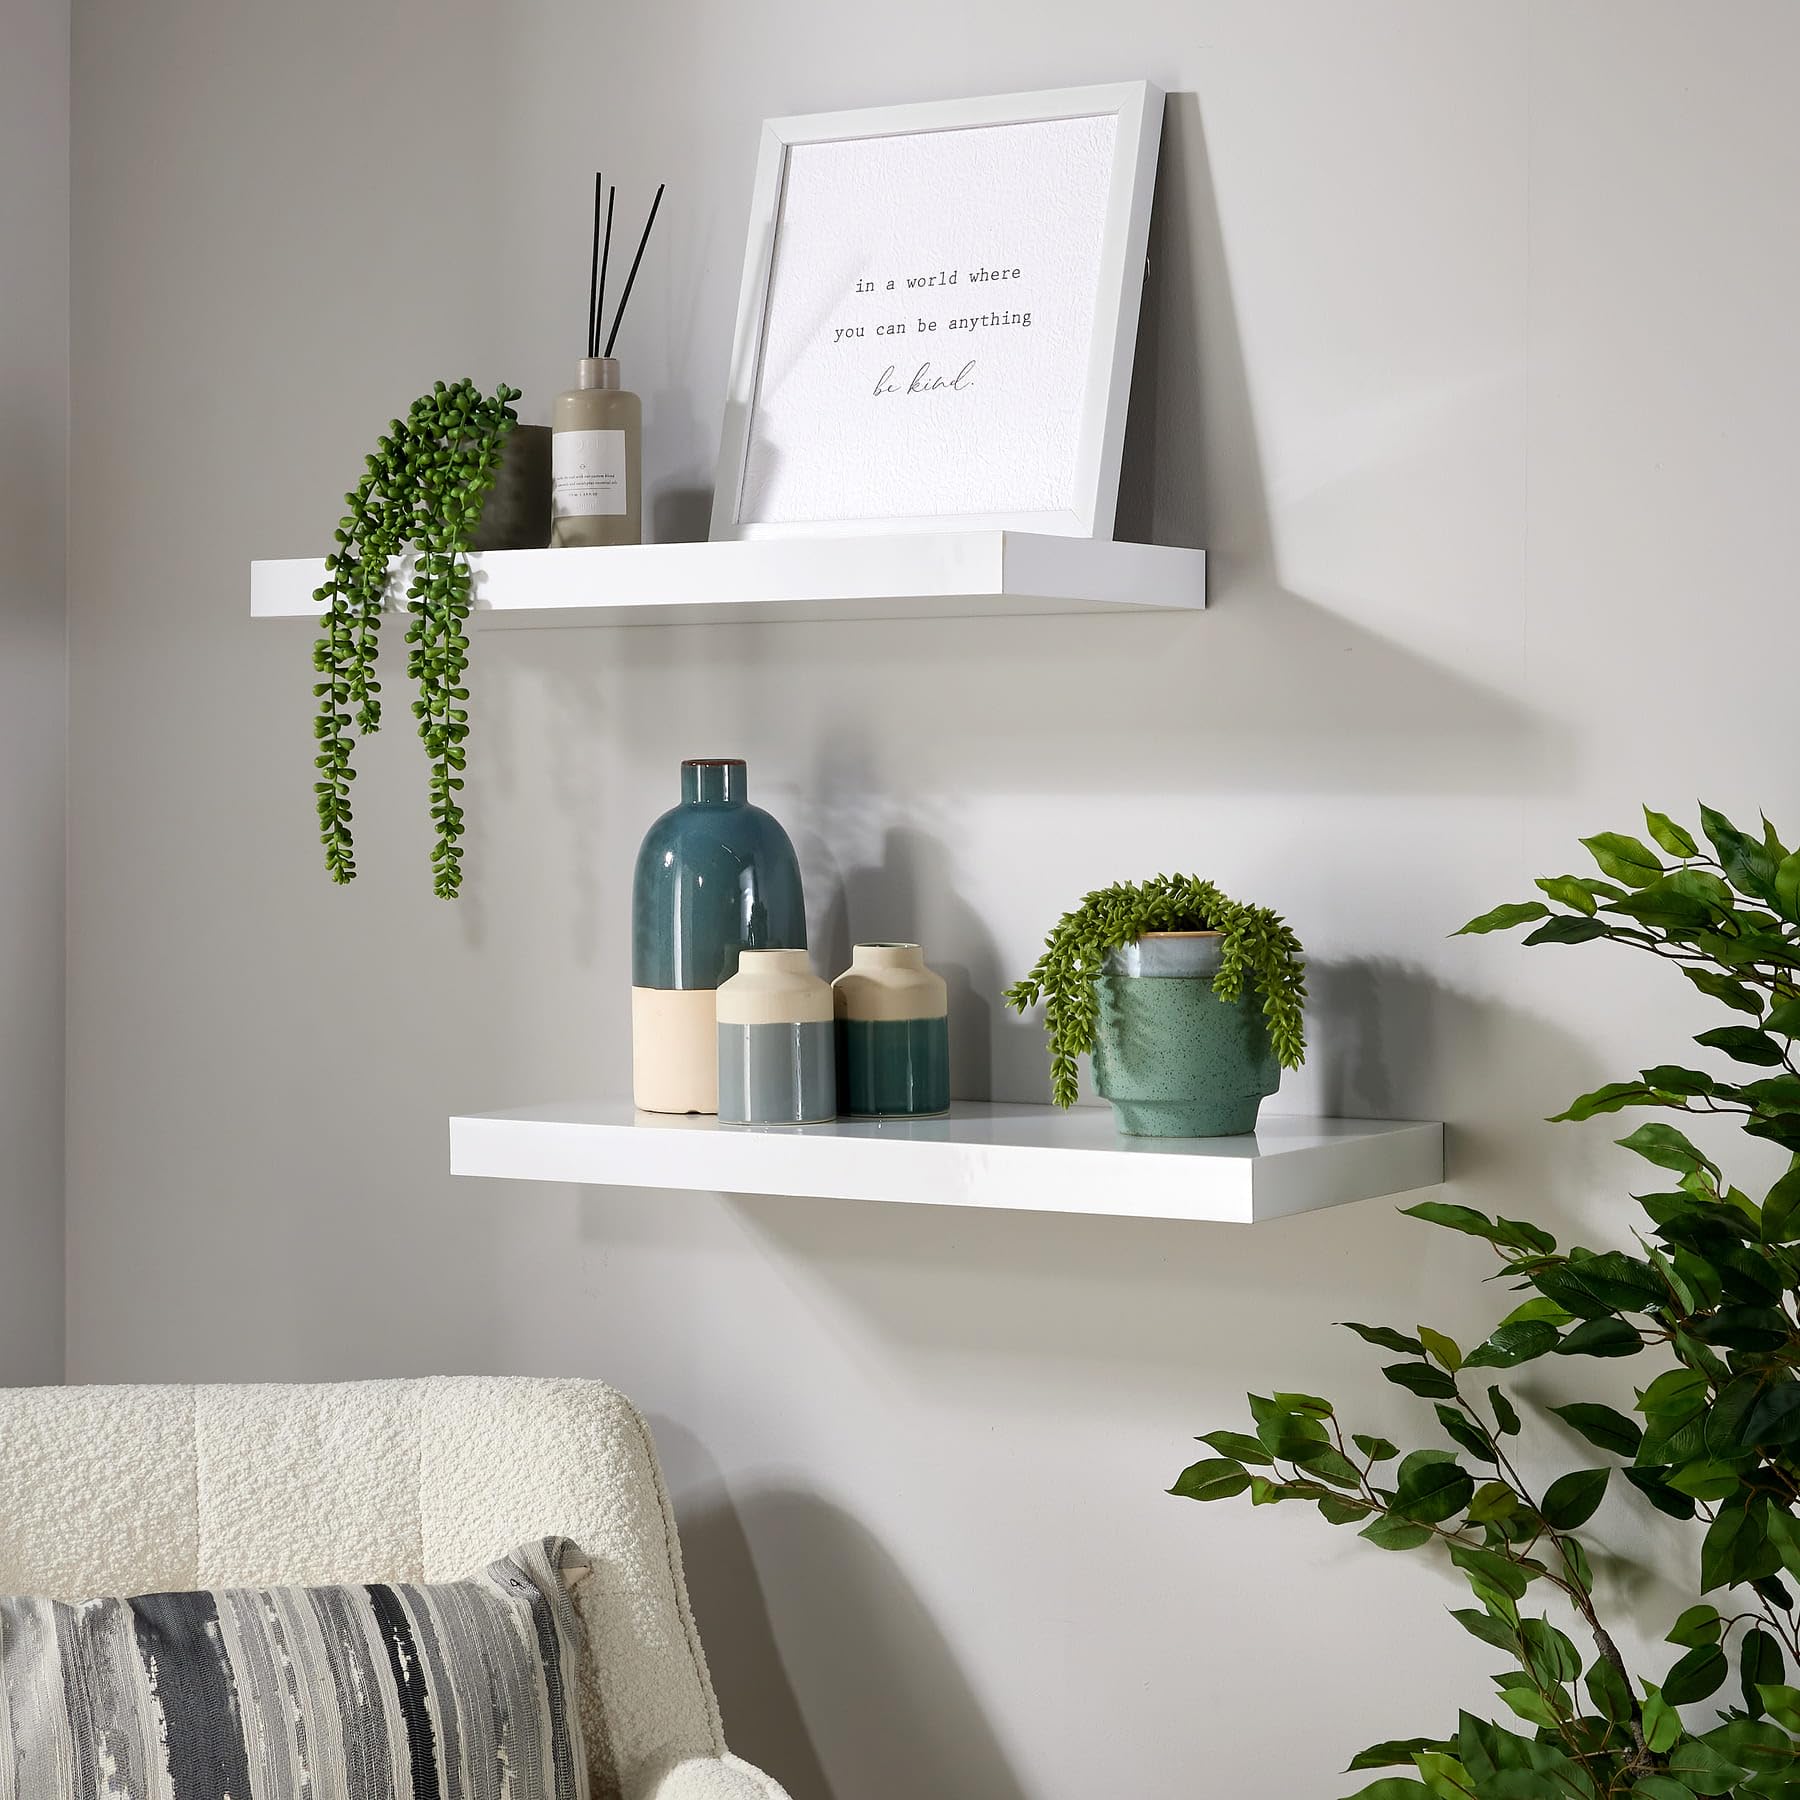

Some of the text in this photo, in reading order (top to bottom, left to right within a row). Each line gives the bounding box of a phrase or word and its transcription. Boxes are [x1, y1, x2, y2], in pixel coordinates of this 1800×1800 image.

[855, 267, 1021, 293] in a world where
[833, 310, 1032, 343] you can be anything
[872, 359, 977, 397] be kind.
